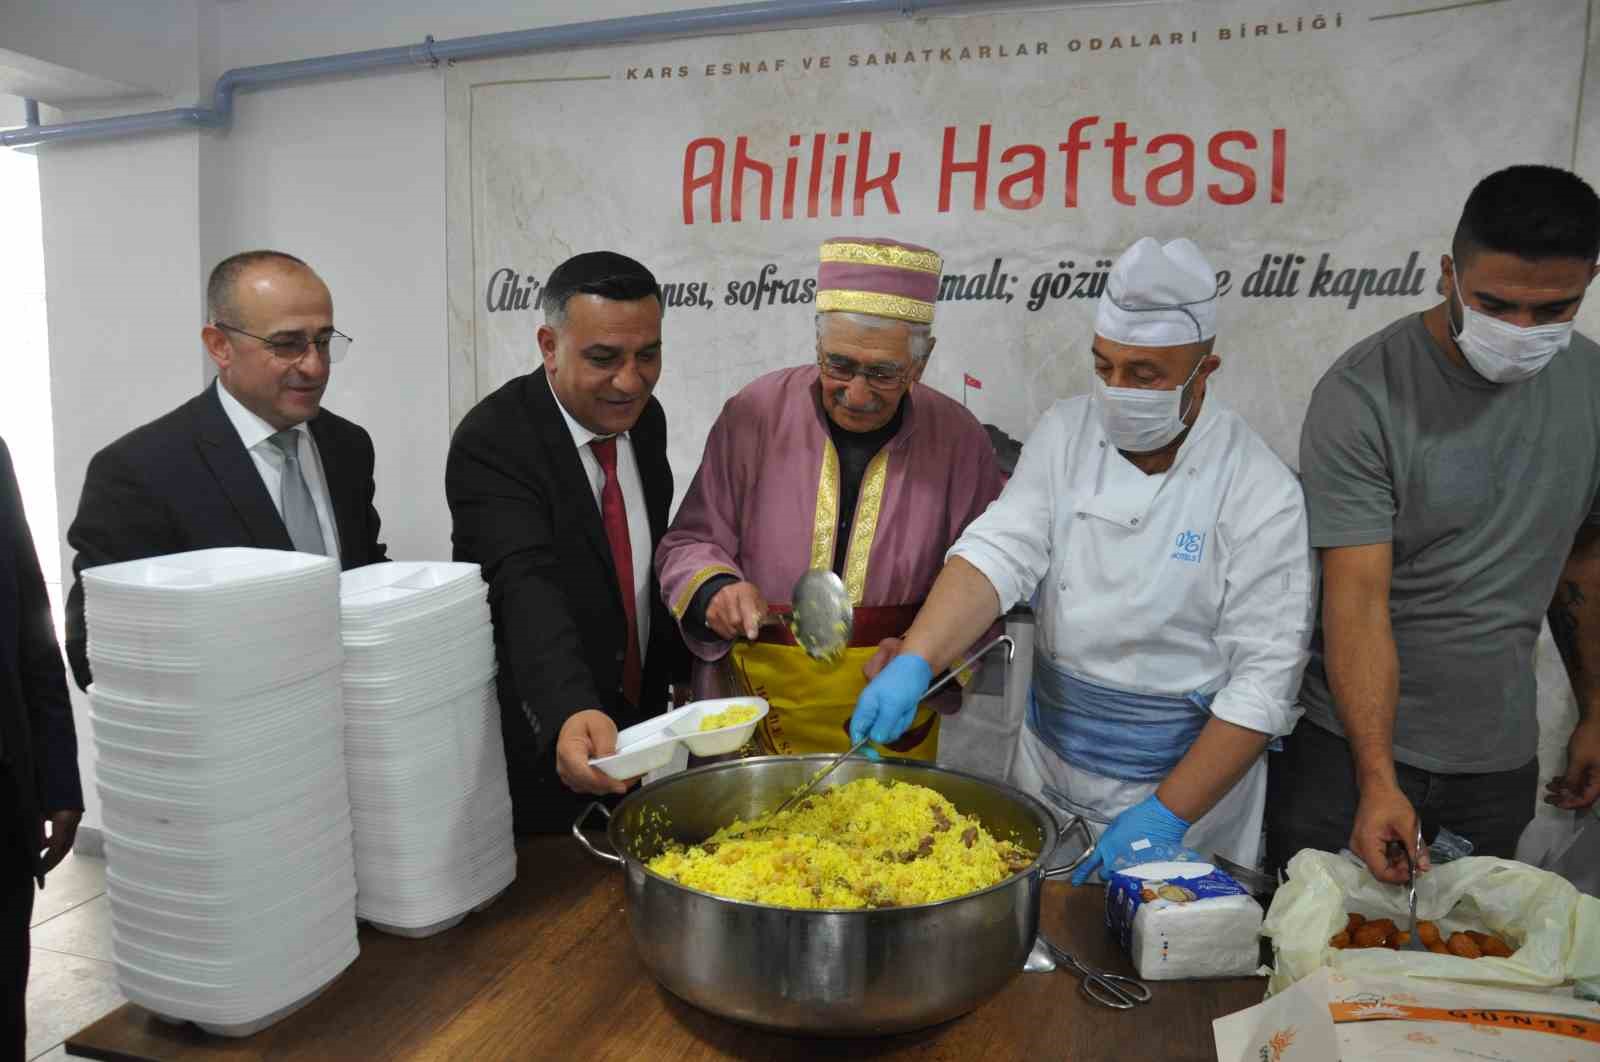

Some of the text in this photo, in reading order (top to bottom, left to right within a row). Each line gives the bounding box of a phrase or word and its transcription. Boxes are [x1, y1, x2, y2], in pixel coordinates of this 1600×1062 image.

[626, 12, 1343, 81] KARS ESNAF VE SANATKARLAR ODALARI BİRLİĞİ
[682, 116, 1287, 225] Ahilik Haftası
[724, 263, 817, 311] sofras
[937, 258, 1019, 305] malı;
[1241, 253, 1306, 299] dili
[1308, 250, 1427, 310] kapalı
